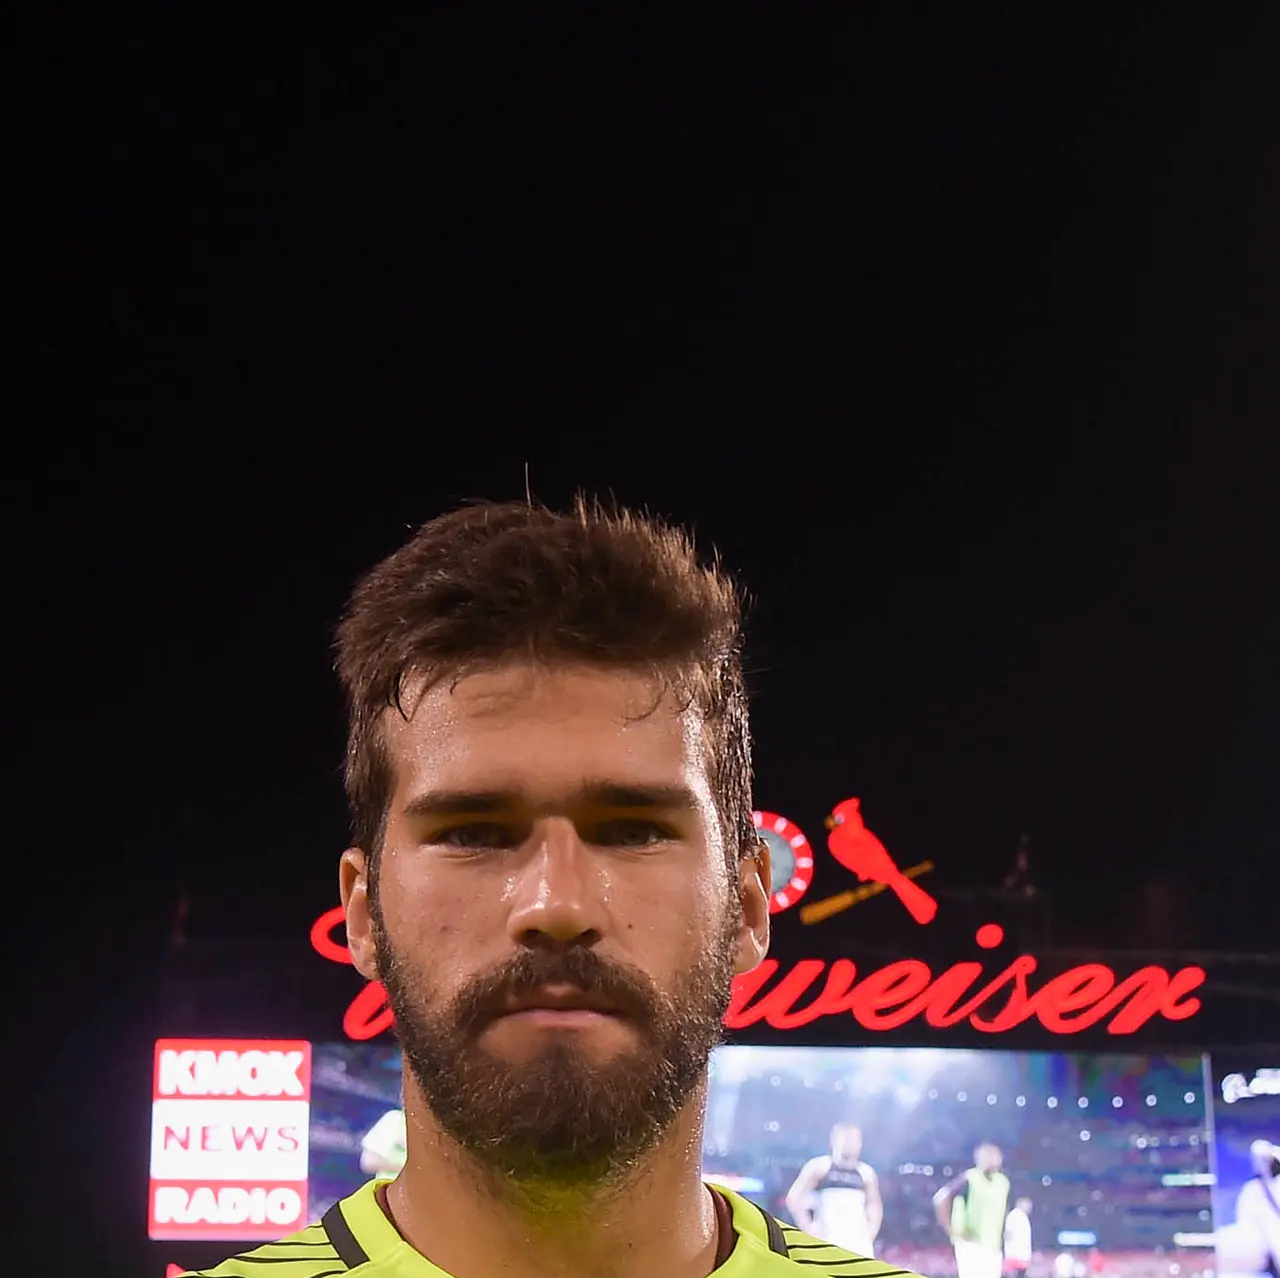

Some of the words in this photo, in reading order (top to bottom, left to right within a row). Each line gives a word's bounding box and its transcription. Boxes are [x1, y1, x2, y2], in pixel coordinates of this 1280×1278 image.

[159, 1050, 305, 1096] KMOX
[164, 1126, 299, 1151] NEWS
[154, 1186, 301, 1225] RADIO
